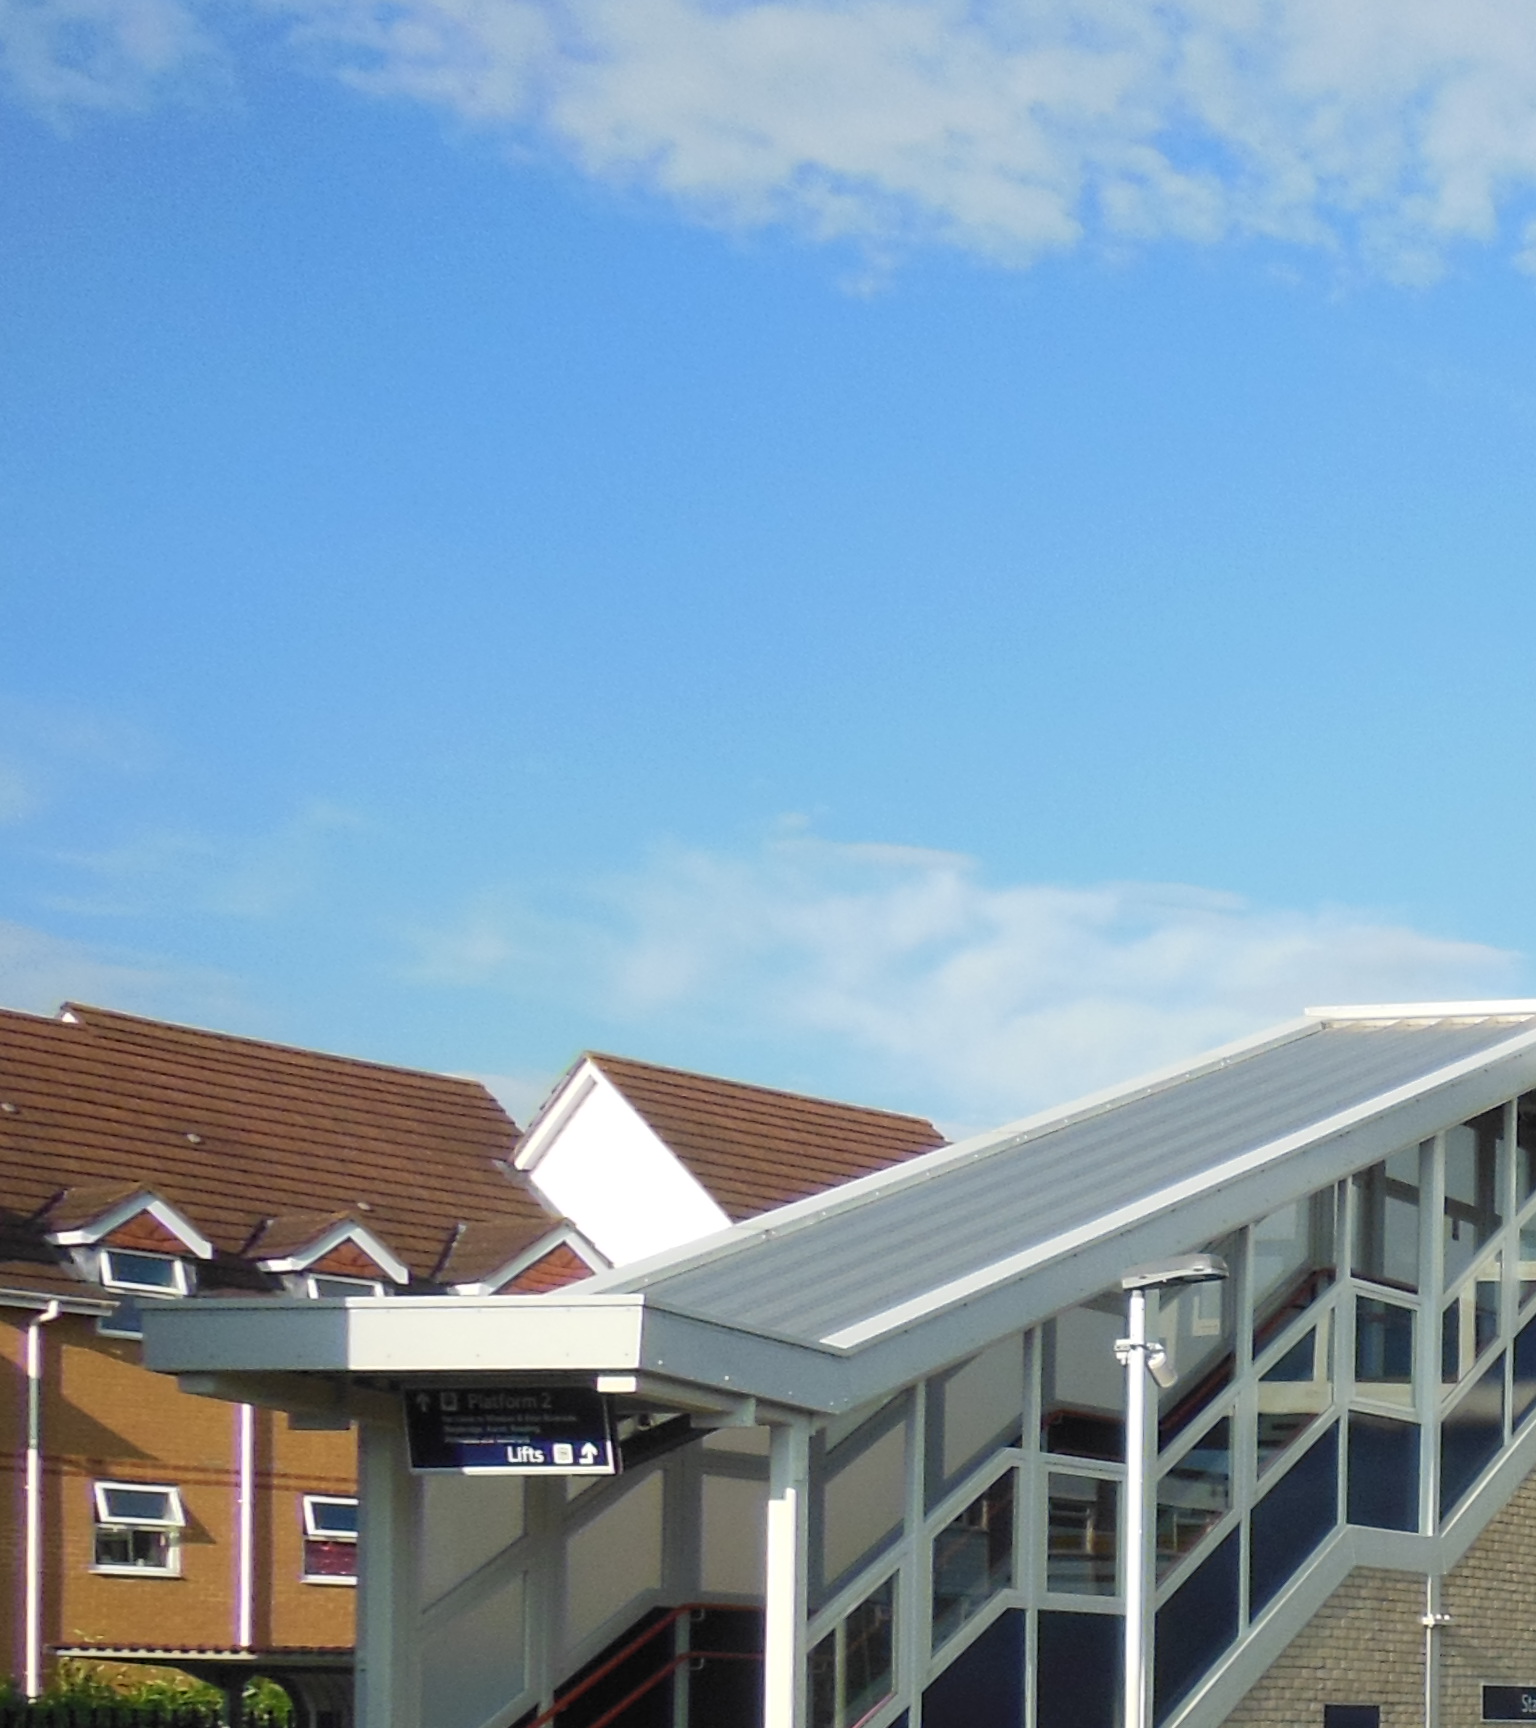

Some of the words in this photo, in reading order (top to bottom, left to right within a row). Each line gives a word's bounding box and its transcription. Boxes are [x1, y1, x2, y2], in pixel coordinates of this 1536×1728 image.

[467, 1392, 538, 1409] Platform
[542, 1392, 552, 1408] 2
[508, 1446, 545, 1464] Lifts
